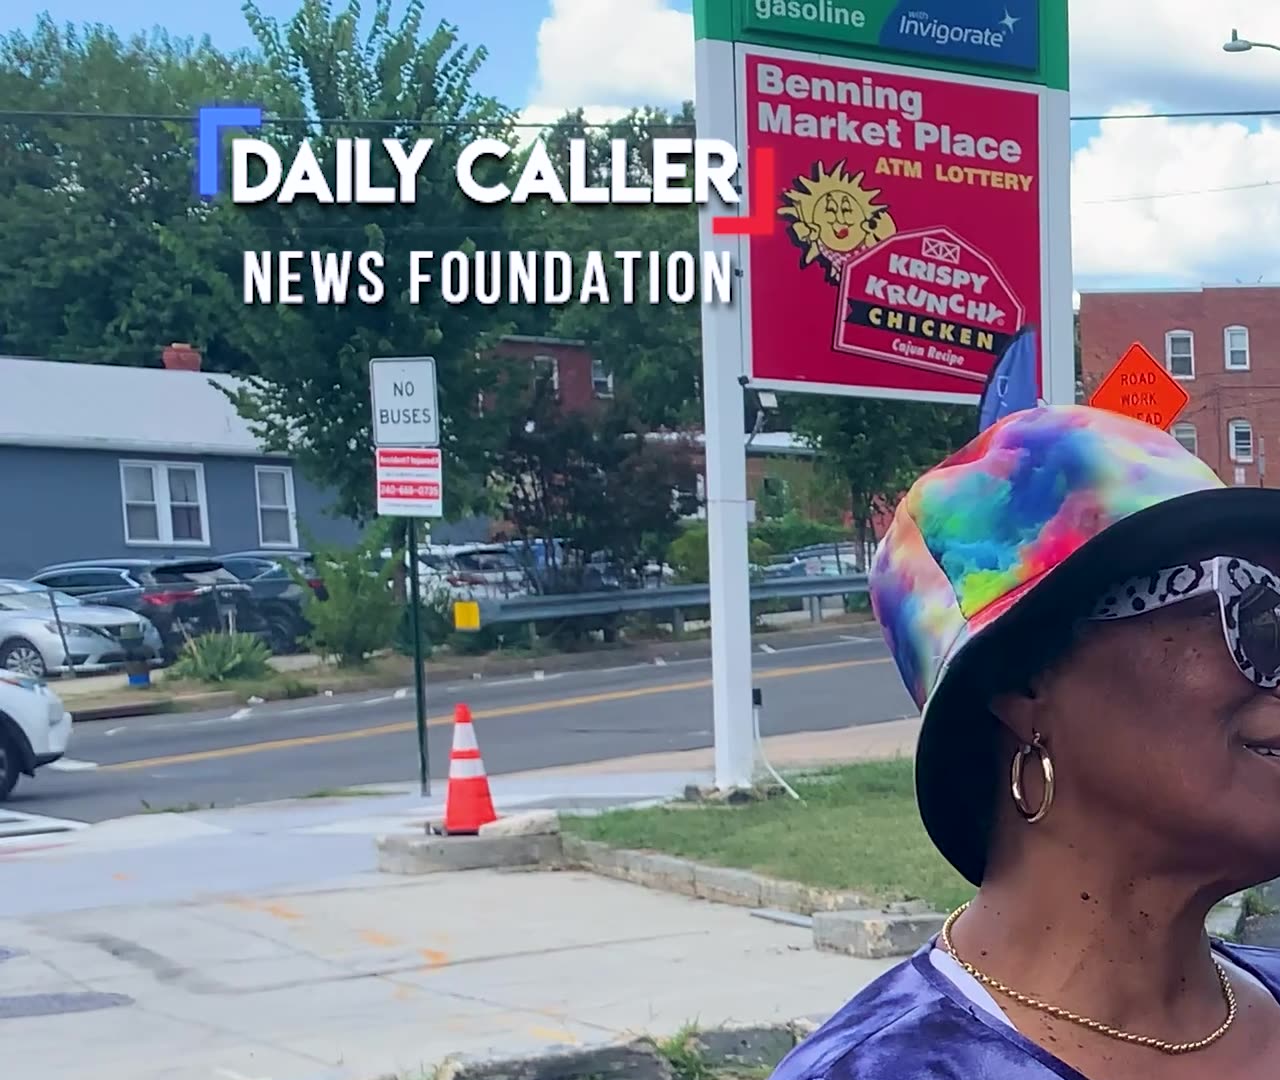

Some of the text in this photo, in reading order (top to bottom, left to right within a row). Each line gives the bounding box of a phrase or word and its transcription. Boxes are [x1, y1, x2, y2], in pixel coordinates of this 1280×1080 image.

[755, 0, 865, 28] gasoline
[908, 10, 929, 20] with
[899, 15, 1003, 47] Invigorate
[757, 63, 923, 120] Benning
[758, 102, 1022, 163] Market Place
[875, 156, 1033, 192] ATM LOTTERY
[888, 252, 989, 294] KRISPY
[865, 275, 1005, 325] KRUNCHY
[868, 307, 994, 351] CHICKEN
[892, 337, 965, 366] Cajun Recipe
[393, 381, 415, 398] NO
[1120, 373, 1157, 386] ROAD
[1121, 392, 1157, 406] WORK
[379, 408, 432, 425] BUSES
